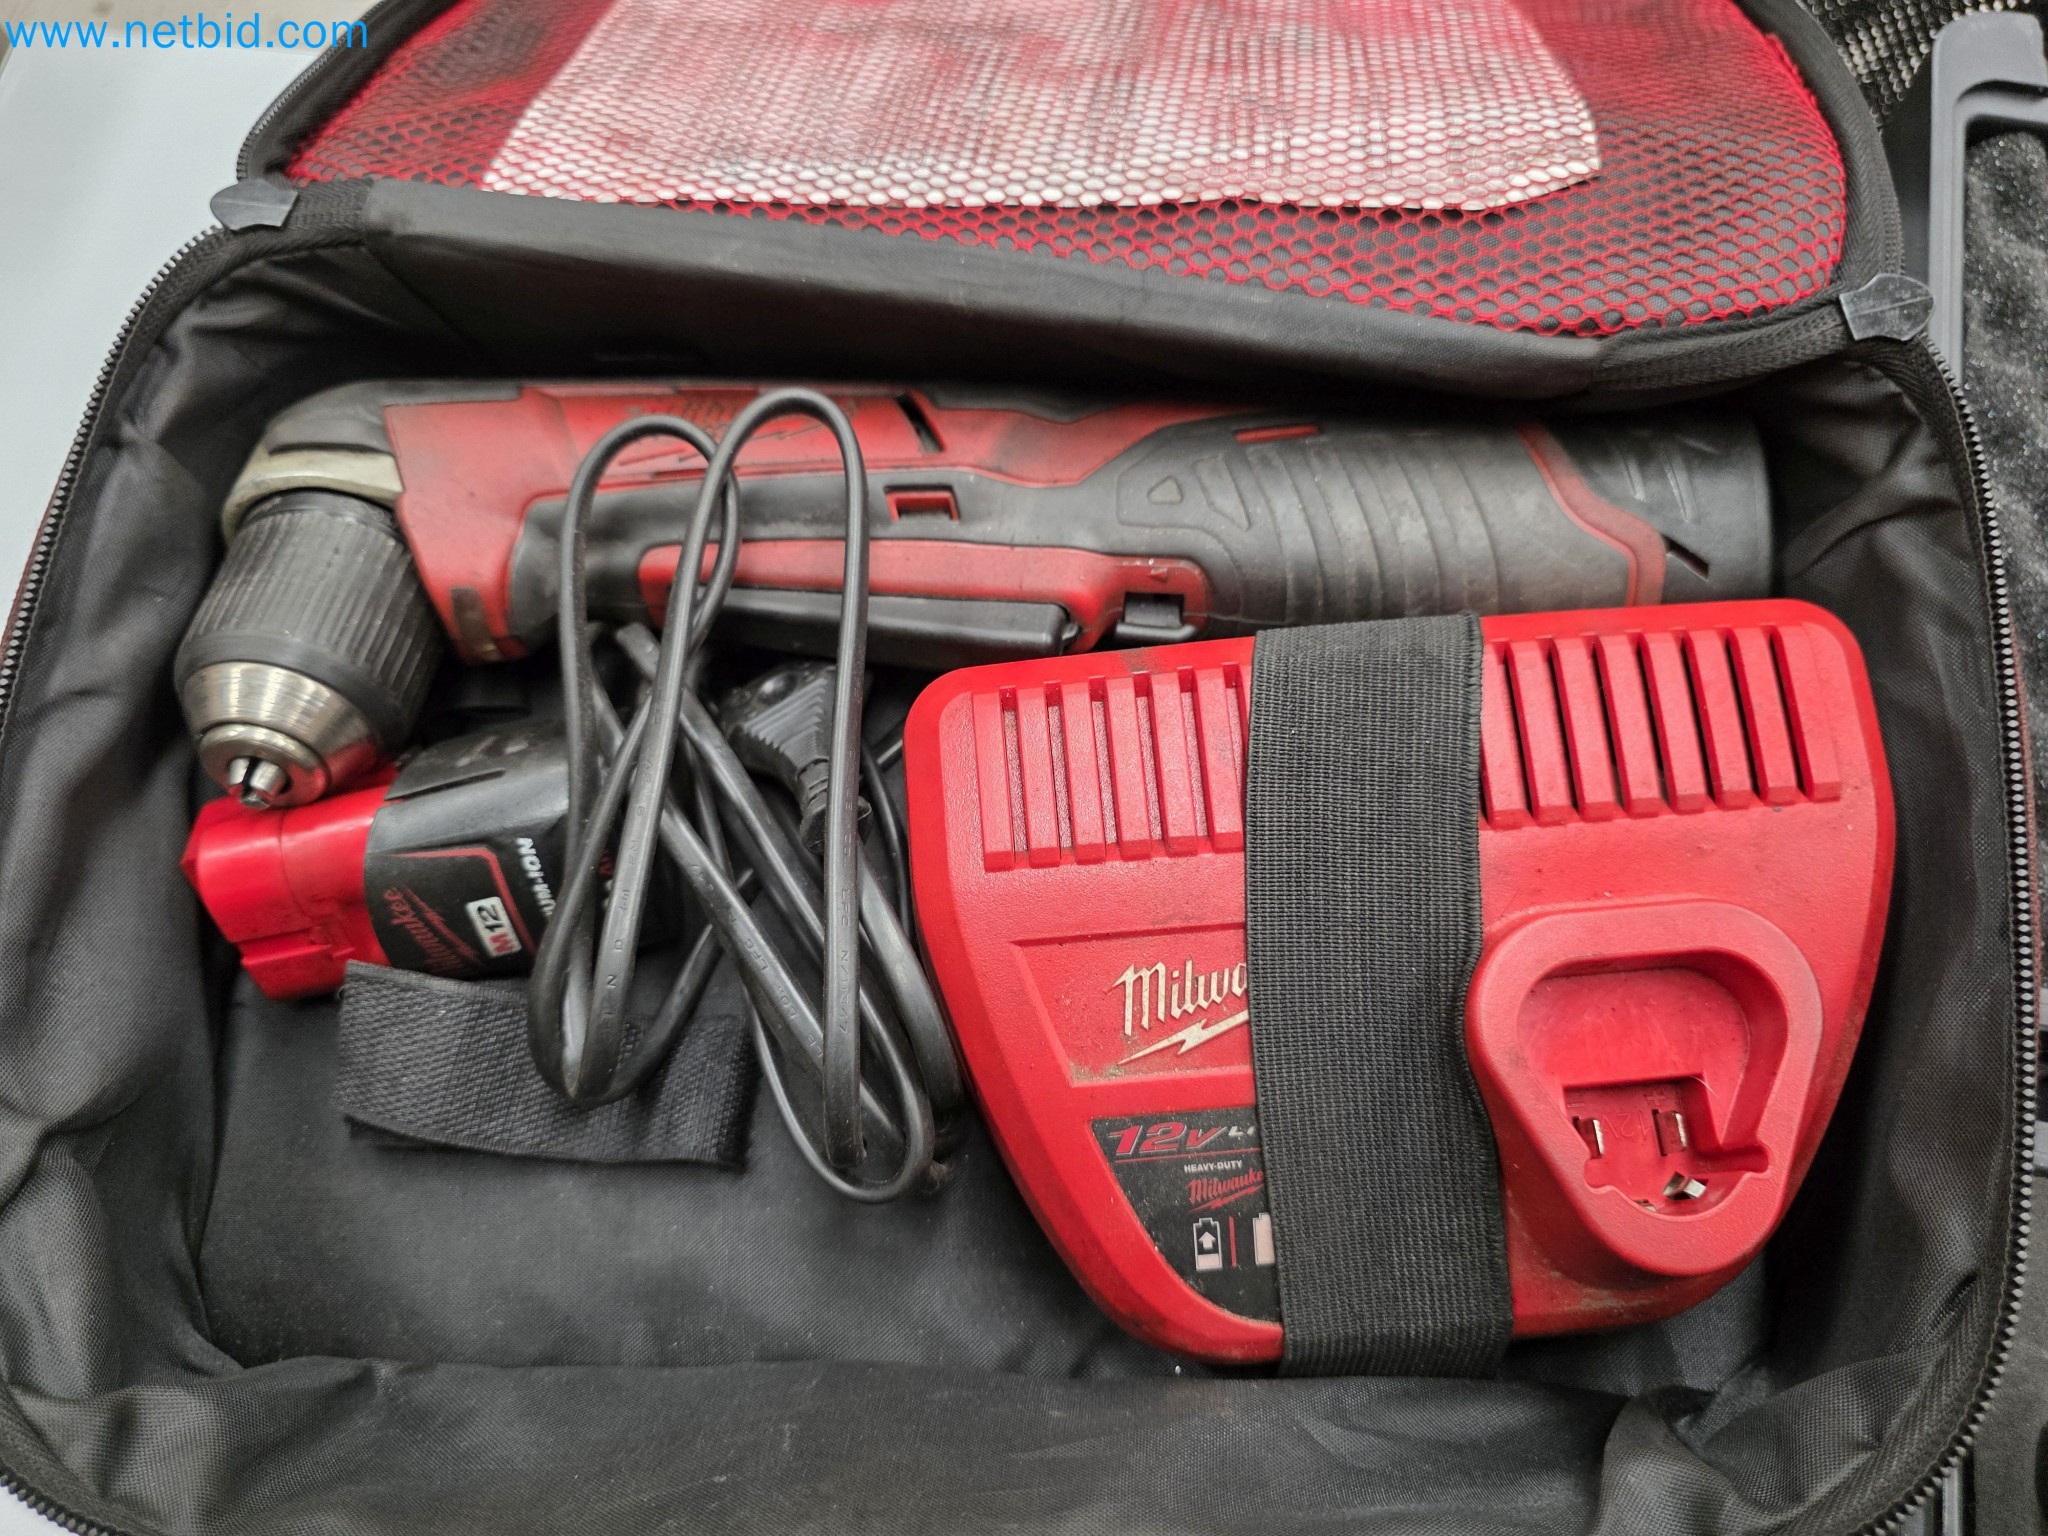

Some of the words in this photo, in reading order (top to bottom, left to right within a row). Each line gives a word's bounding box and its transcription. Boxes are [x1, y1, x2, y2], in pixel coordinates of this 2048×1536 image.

[475, 903, 517, 956] M12
[1110, 959, 1248, 1037] Milwa
[1183, 1159, 1243, 1174] HEAVY-DUTY
[1185, 1167, 1265, 1205] Milwauke
